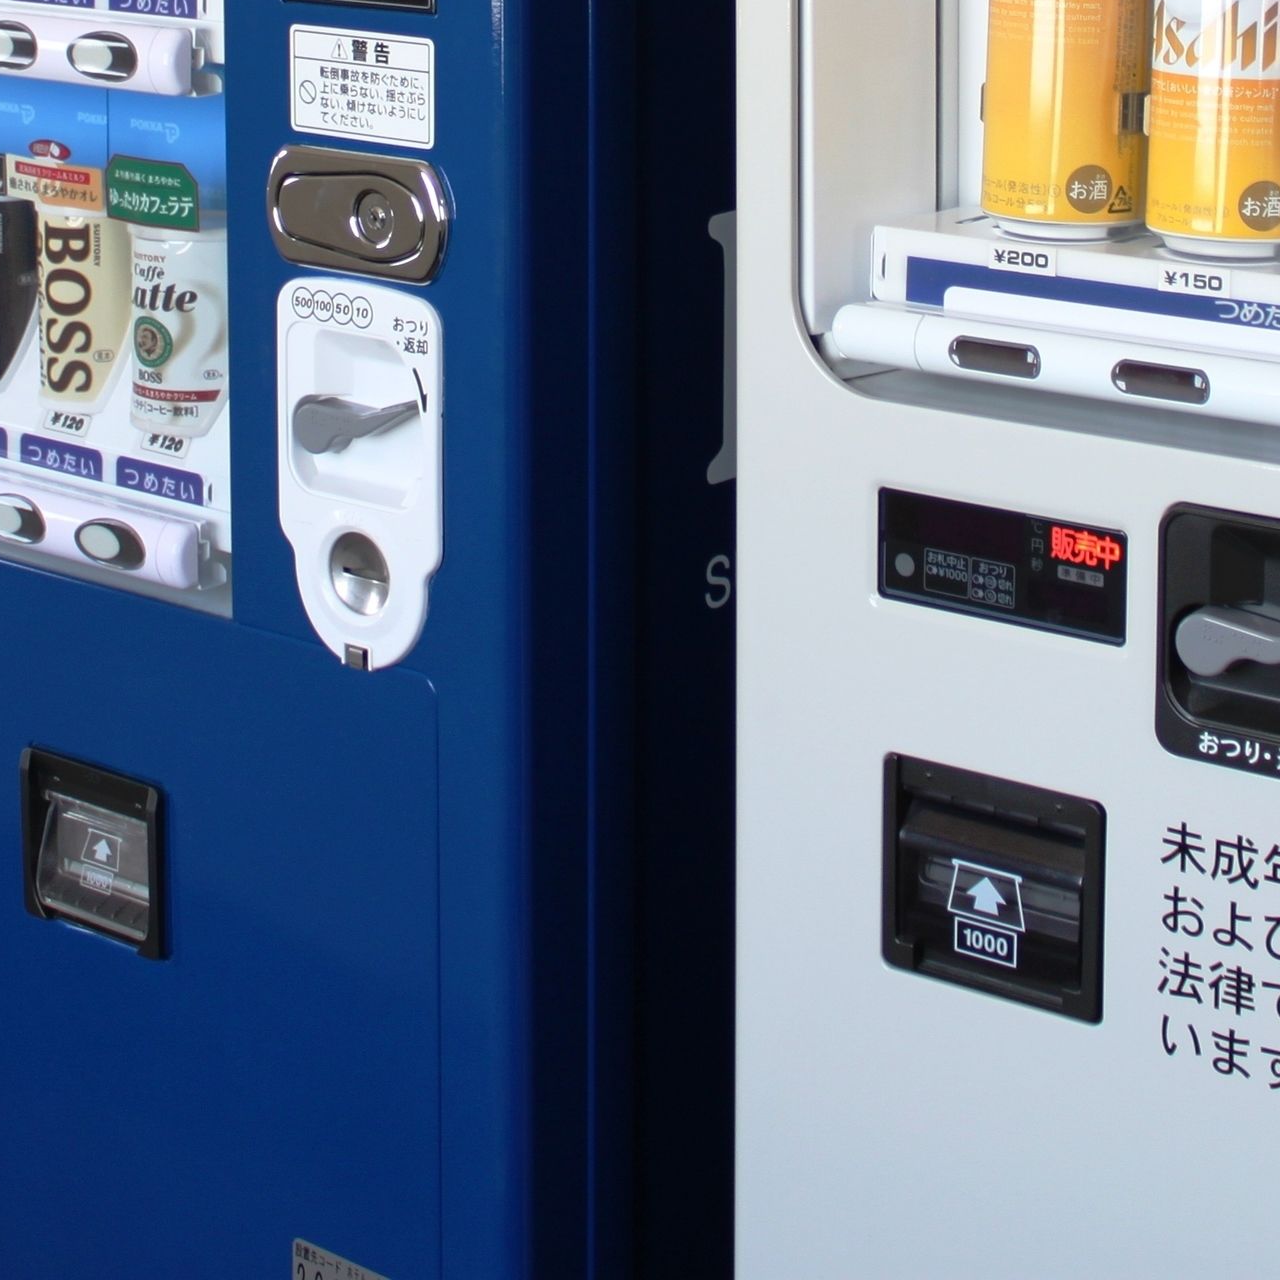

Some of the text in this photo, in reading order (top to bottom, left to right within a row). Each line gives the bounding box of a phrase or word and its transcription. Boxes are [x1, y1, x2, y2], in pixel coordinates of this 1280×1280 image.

[351, 39, 391, 66] 警告
[320, 65, 424, 90] 転倒事故を防ぐために、
[320, 82, 426, 106] 上に乗らない、揺さぶら
[320, 97, 426, 121] ない、傾けないようにし
[320, 110, 375, 131] てください。
[1069, 180, 1108, 201] お酒
[93, 223, 101, 267] SUNTORY
[993, 249, 1049, 269] ¥200
[1164, 271, 1223, 292] ¥150
[45, 220, 92, 393] BOSS
[132, 283, 198, 314] atte
[294, 295, 369, 320] 500 100 50 10
[392, 316, 429, 336] おつり
[138, 369, 163, 385] BOSS
[50, 411, 85, 431] ¥120
[147, 433, 184, 453] ¥120
[27, 444, 95, 477] つめたい
[123, 465, 196, 500] つめたい
[1030, 538, 1044, 555] 円
[1050, 526, 1121, 571] 販売中
[926, 551, 967, 571] お札中止
[978, 562, 1008, 578] おつり
[938, 568, 968, 584] ¥1000
[961, 928, 1010, 958] 1000
